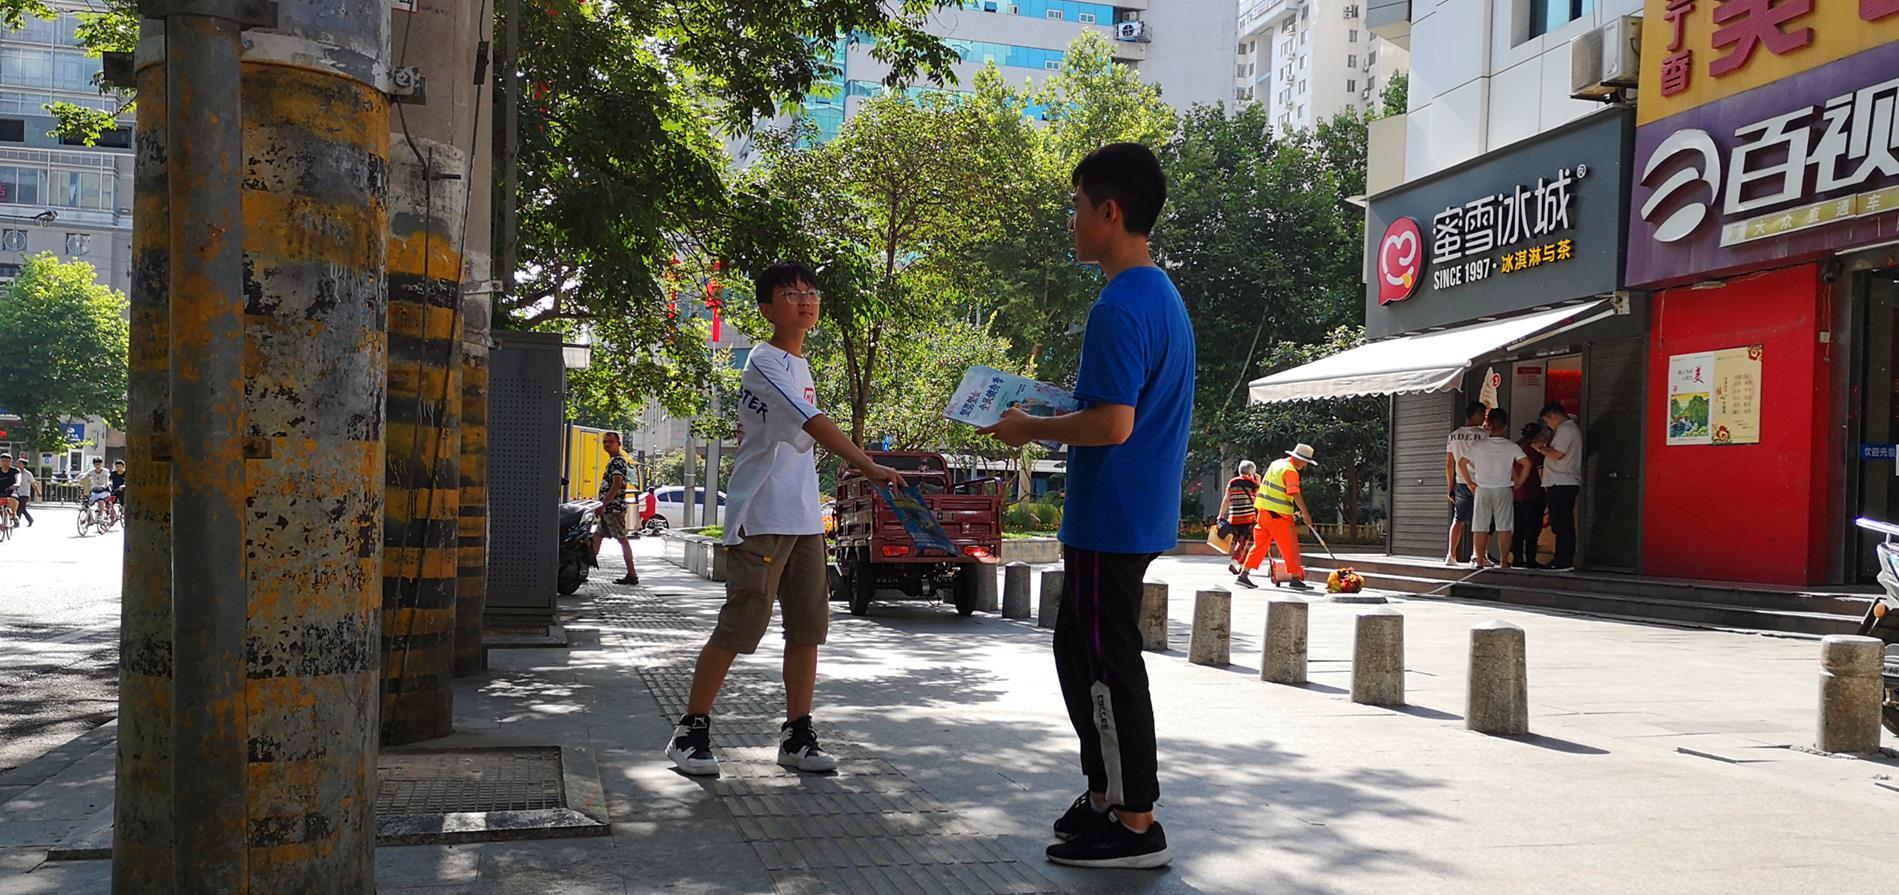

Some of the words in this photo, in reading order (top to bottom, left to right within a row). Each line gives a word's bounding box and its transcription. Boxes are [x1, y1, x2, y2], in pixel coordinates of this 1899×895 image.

[1432, 168, 1572, 265] 蜜雪冰城
[1433, 262, 1463, 291] SINCE
[1465, 257, 1491, 285] 1997
[1501, 239, 1573, 274] 冰淇淋与茶
